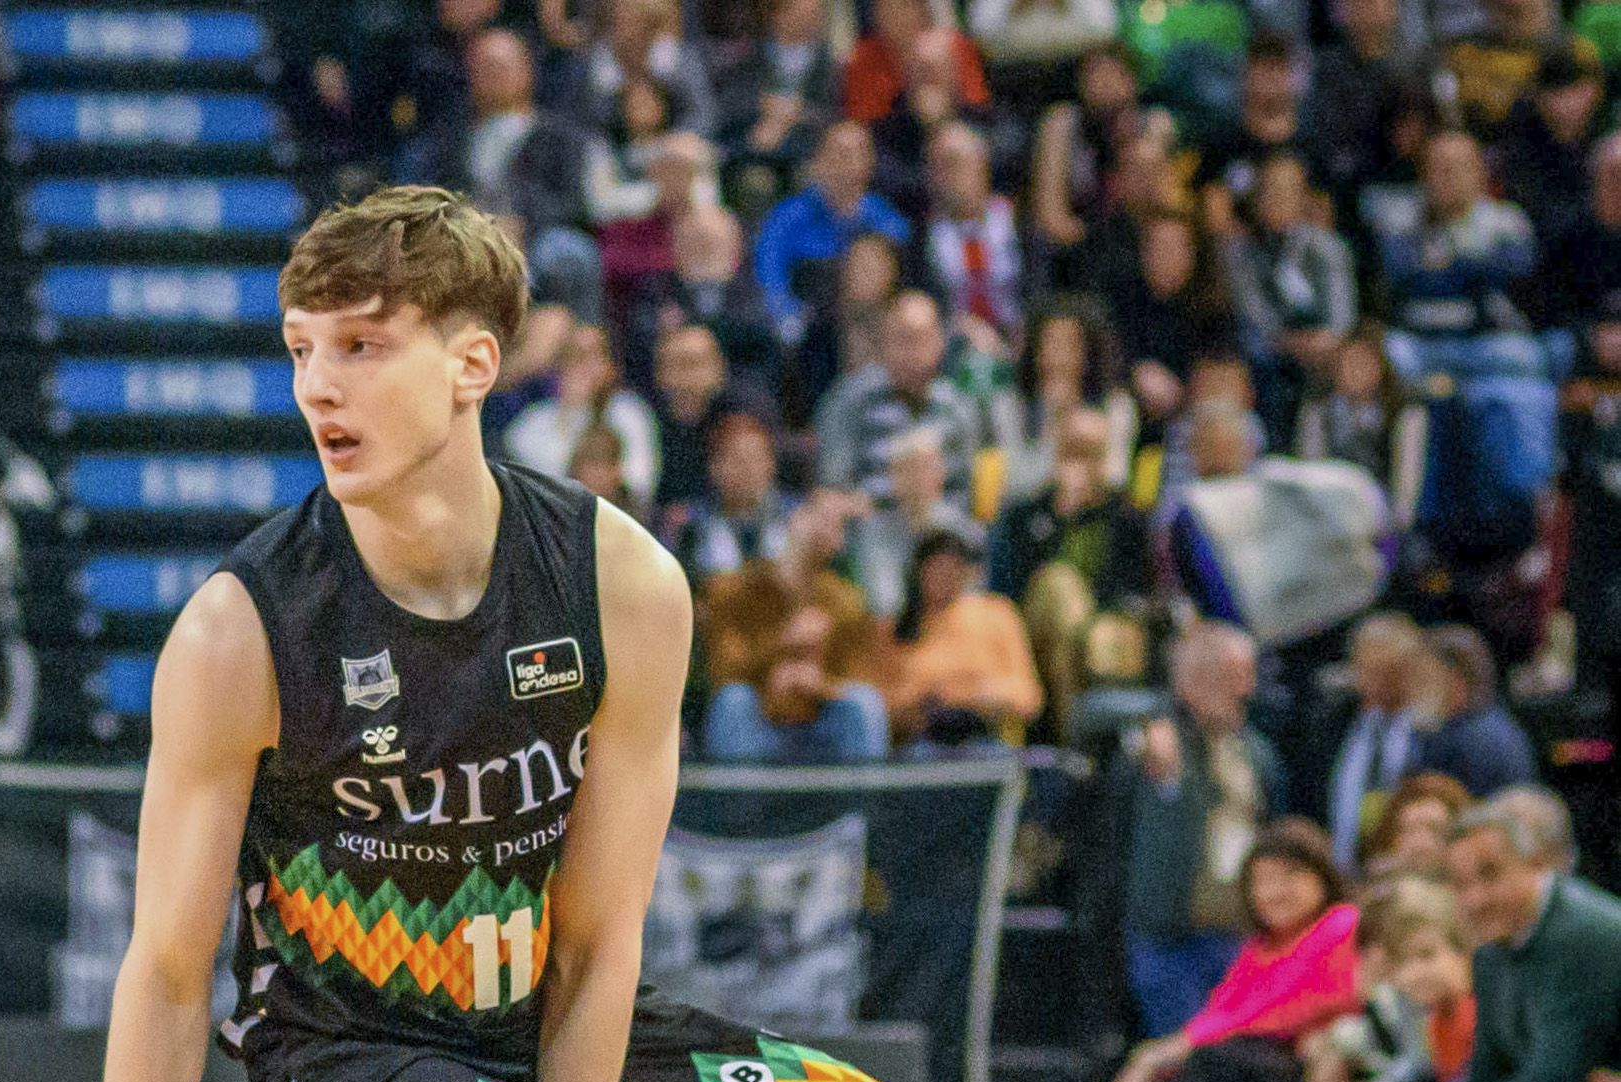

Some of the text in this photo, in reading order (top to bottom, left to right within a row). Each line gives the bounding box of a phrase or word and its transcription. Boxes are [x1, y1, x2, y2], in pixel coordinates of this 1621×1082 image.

[515, 663, 544, 680] liga
[518, 669, 578, 693] endesa
[335, 812, 571, 867] seguros & pensi
[462, 906, 533, 1010] 11
